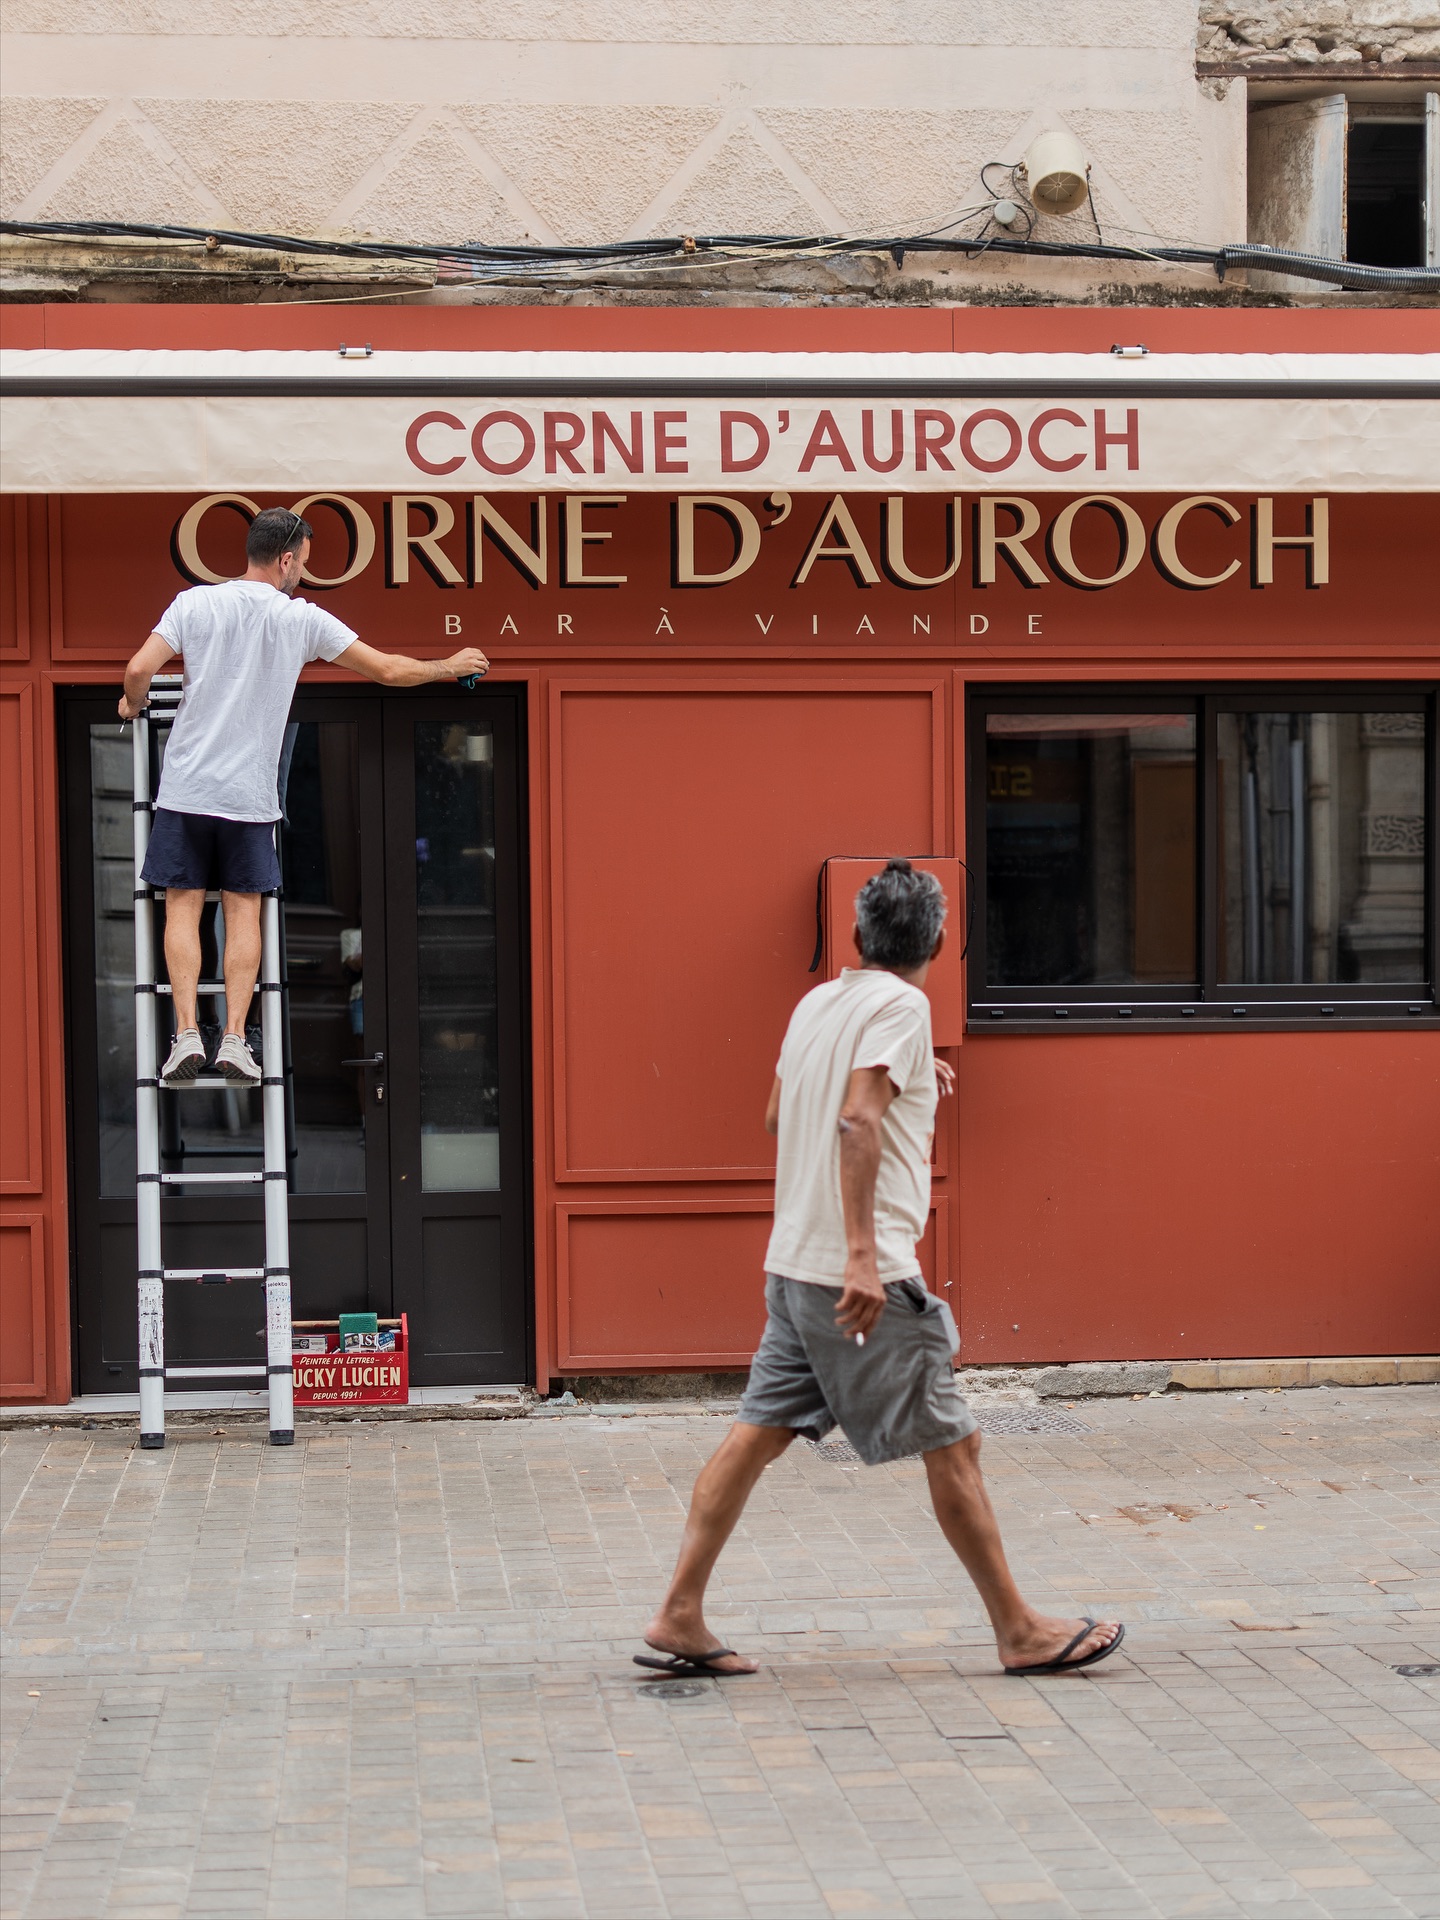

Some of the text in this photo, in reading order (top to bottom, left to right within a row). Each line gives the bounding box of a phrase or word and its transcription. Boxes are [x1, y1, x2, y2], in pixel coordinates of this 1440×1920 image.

[406, 408, 1140, 475] CORNE D’AUROCH
[177, 492, 1330, 586] CORNE D’AUROCH
[445, 607, 1044, 635] BAR À VIANDE
[333, 1357, 344, 1365] EN
[292, 1366, 401, 1388] UCKY LUCIEN
[312, 1392, 338, 1400] DEPUIS
